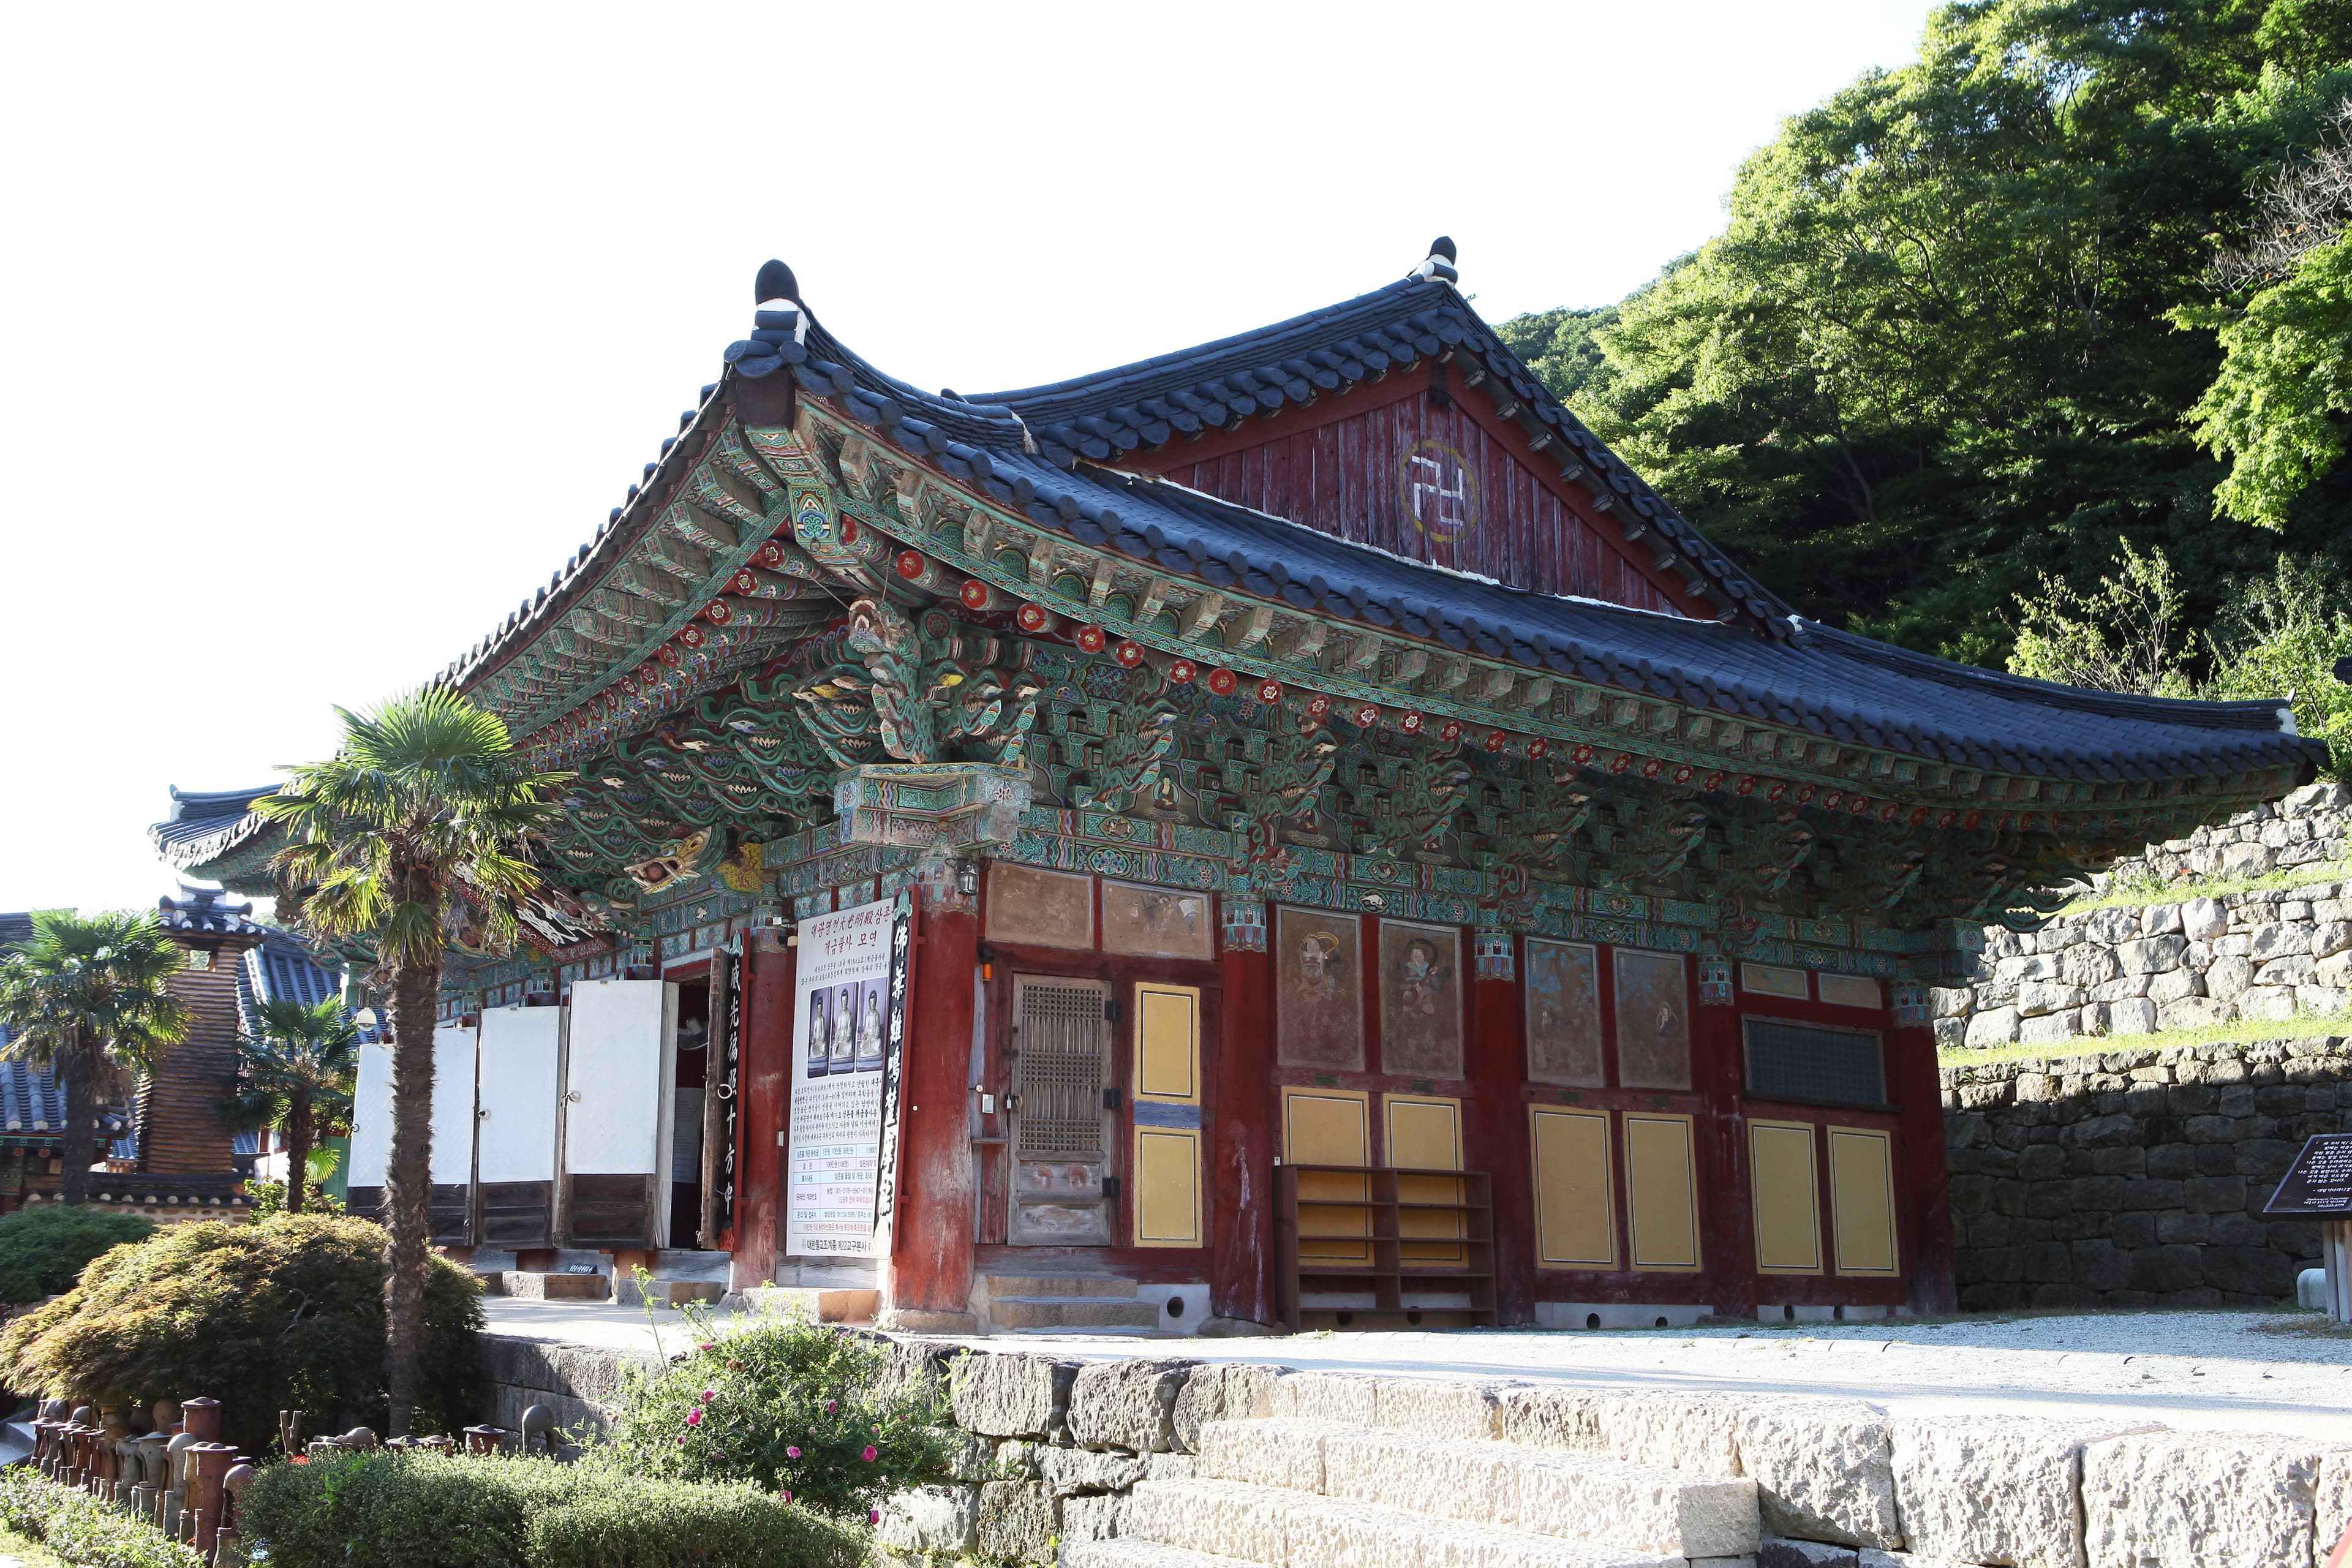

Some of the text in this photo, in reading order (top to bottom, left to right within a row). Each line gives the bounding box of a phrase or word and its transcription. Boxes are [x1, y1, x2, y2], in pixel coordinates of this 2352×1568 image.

[811, 905, 894, 940] 대광명전大光明殿삼존
[824, 930, 877, 956] 개금불사 모연
[807, 1240, 837, 1250] 대한불교조계종
[838, 1240, 867, 1251] 제22교구본사
